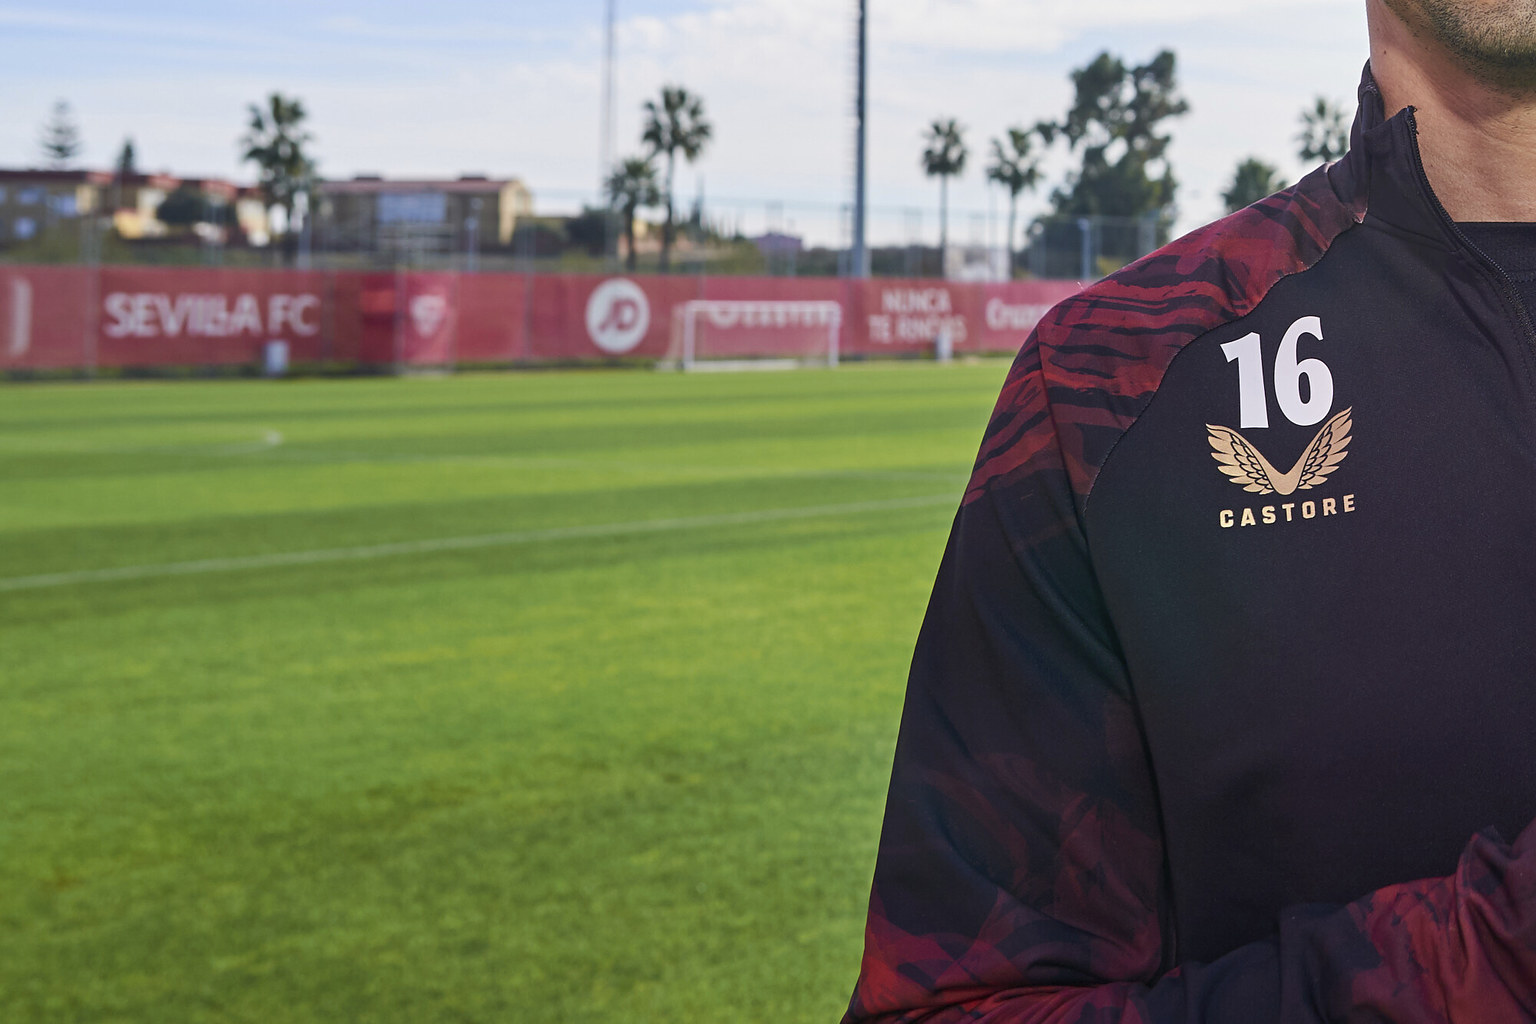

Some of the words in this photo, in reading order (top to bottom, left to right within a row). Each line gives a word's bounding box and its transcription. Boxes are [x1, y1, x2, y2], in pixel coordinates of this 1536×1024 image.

[104, 291, 264, 337] SEVILLA
[267, 293, 320, 336] FC
[1219, 315, 1334, 429] 16
[1219, 494, 1356, 528] CASTORE
